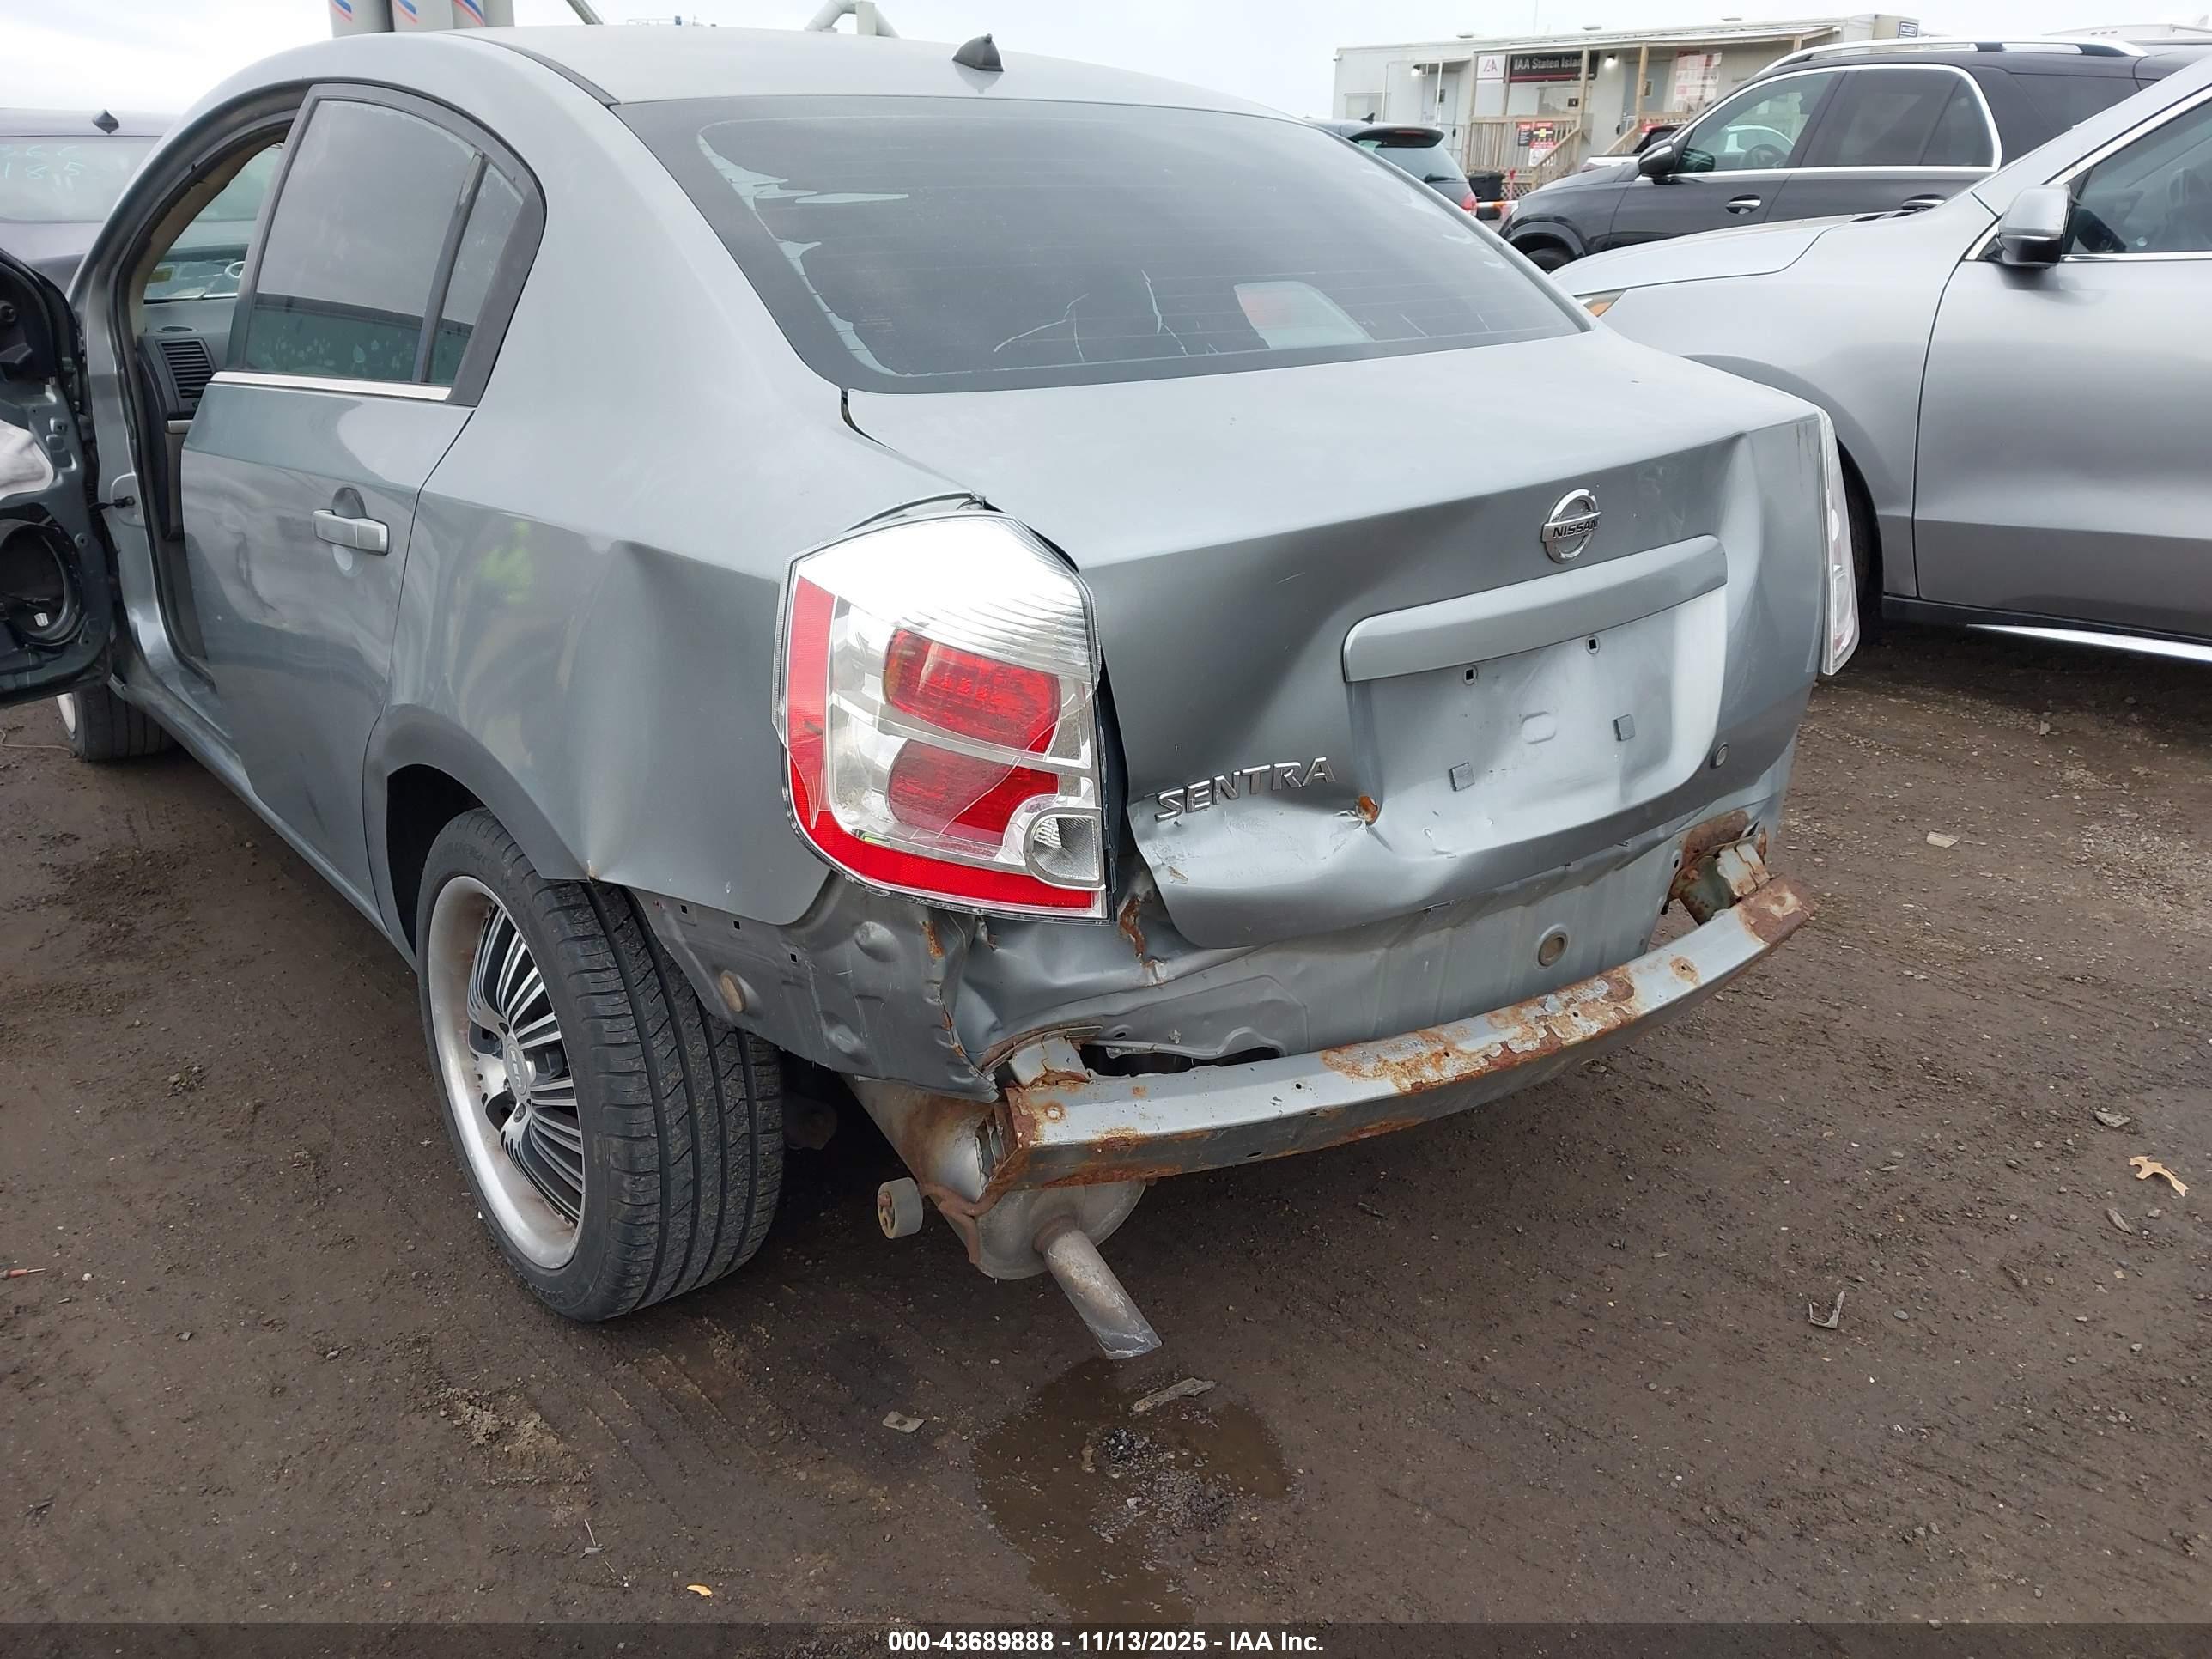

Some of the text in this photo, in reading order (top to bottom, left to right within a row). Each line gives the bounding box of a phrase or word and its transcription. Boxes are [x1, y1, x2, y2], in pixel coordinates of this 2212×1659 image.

[1514, 58, 1530, 70] IAA
[1532, 57, 1559, 70] Staten
[1552, 518, 1599, 539] NISSAN
[1154, 756, 1336, 823] SENTRA
